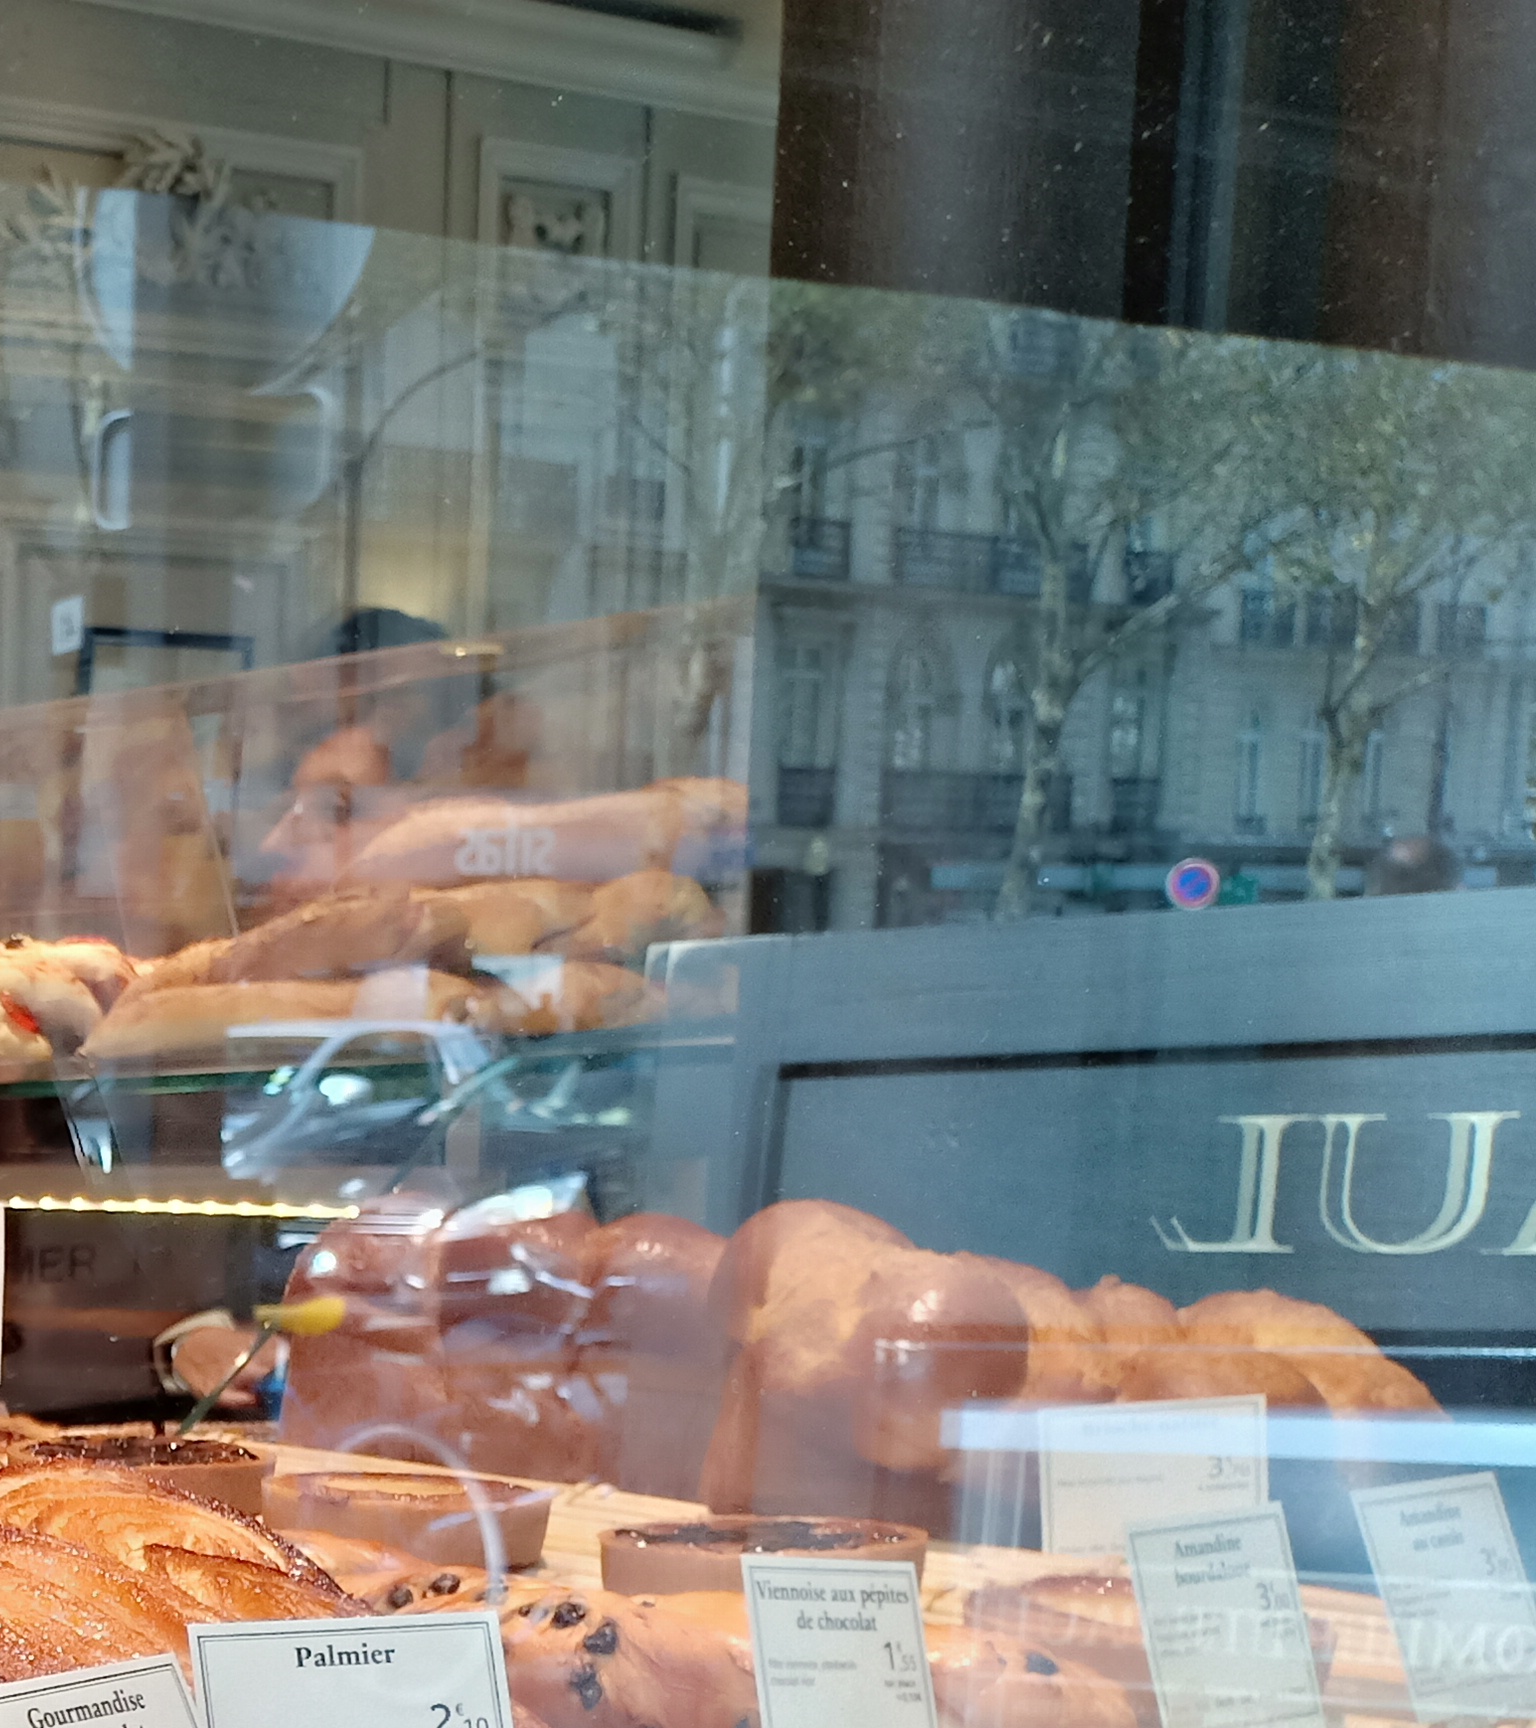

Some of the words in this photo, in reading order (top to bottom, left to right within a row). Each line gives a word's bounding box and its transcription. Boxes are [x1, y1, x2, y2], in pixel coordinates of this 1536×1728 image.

[1174, 1533, 1242, 1559] Amandine
[756, 1580, 826, 1602] Viennoise
[831, 1589, 856, 1602] aux
[860, 1583, 910, 1609] pépites
[797, 1610, 814, 1631] de
[817, 1611, 878, 1632] chocolat
[295, 1642, 396, 1668] Palmier
